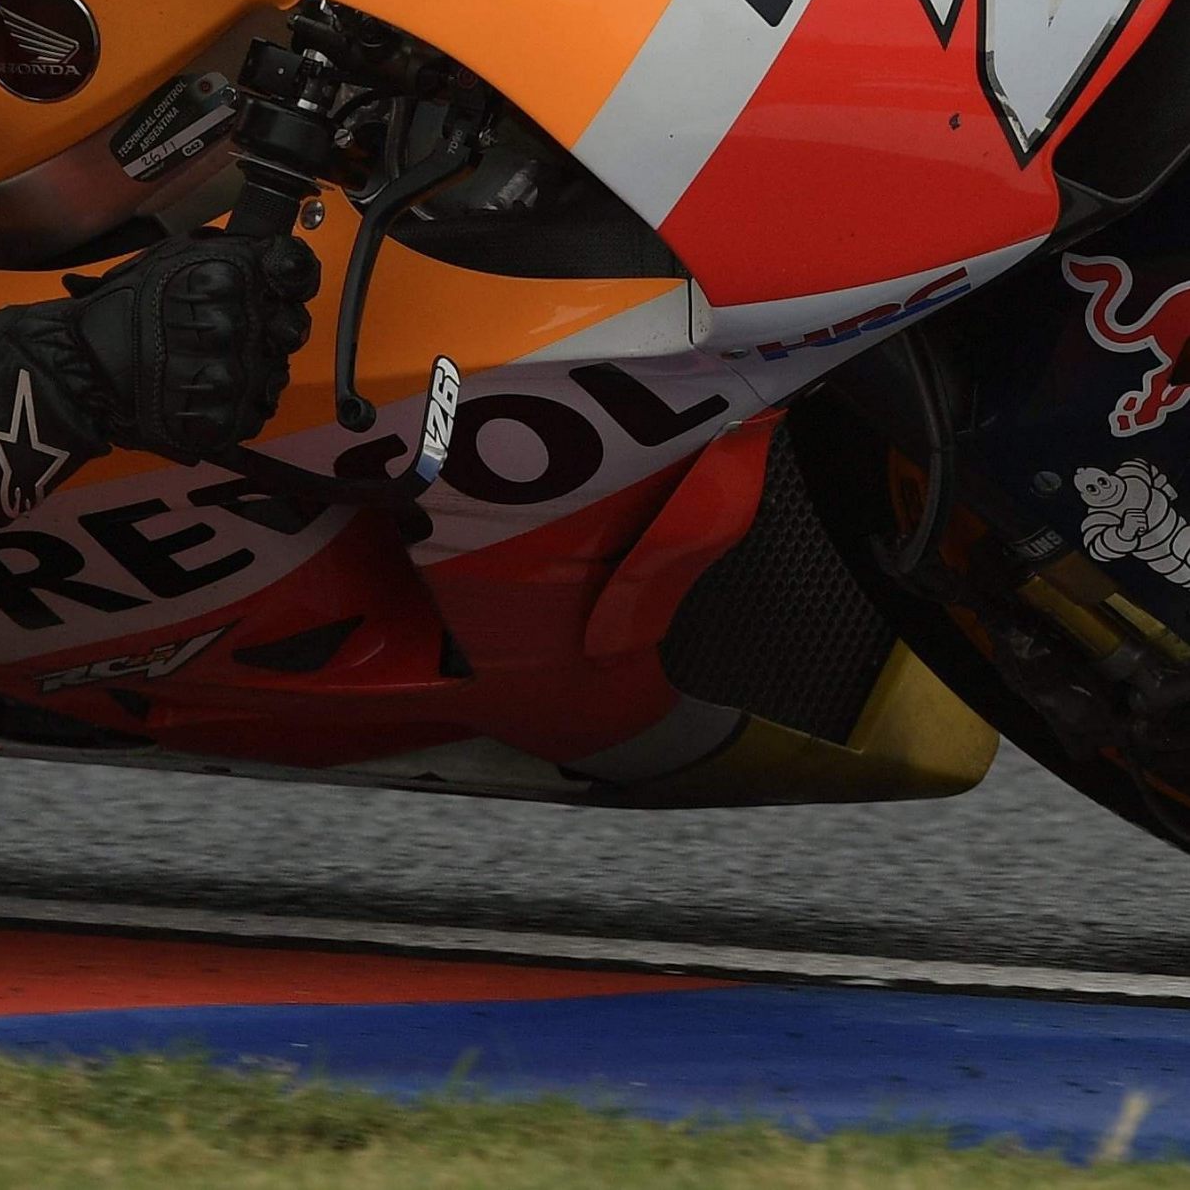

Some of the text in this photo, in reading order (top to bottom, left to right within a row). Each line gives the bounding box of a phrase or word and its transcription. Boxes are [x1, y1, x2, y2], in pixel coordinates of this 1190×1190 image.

[0, 62, 82, 77] HONDA
[117, 115, 156, 158] TECHNICAL
[153, 79, 189, 118] CONTROL
[138, 106, 180, 152] ARGENTINA
